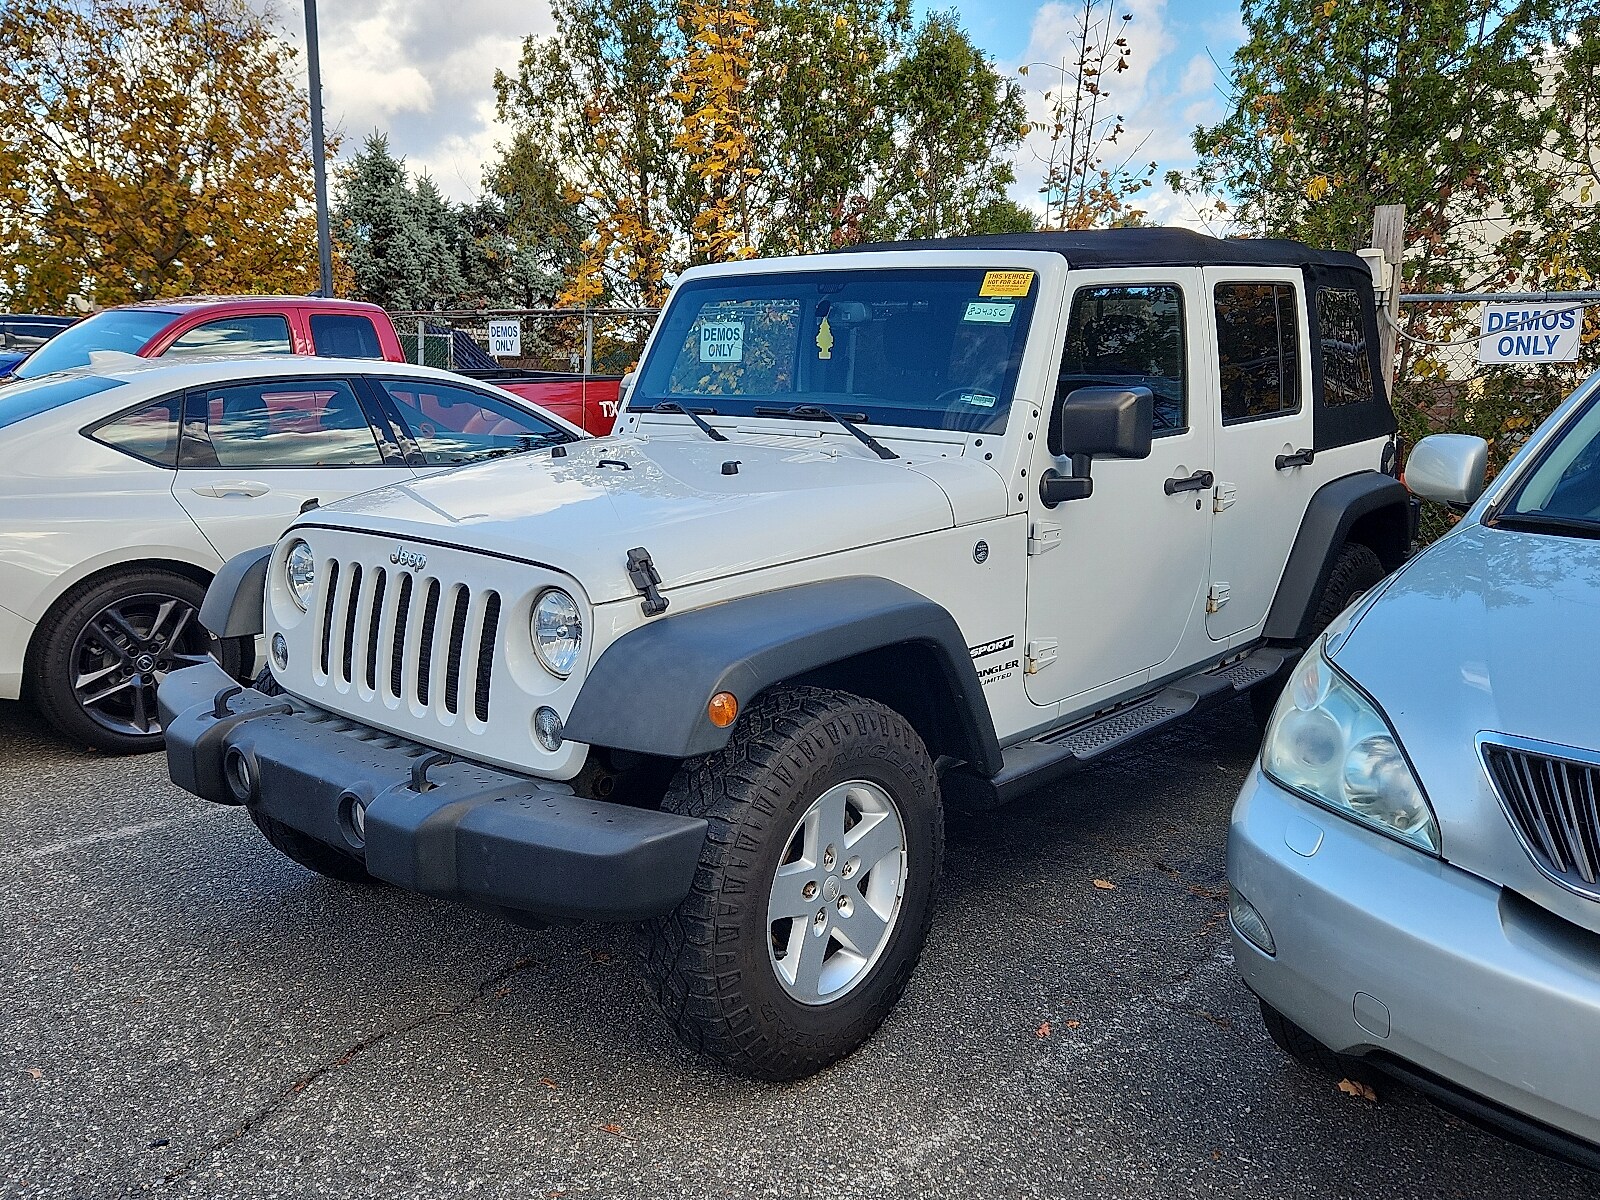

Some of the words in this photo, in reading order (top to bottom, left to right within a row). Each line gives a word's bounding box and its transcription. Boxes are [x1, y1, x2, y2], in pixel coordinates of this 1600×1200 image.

[1487, 309, 1576, 333] DEMOS
[490, 325, 518, 338] DEMOS
[703, 327, 740, 342] DEMOS
[495, 339, 515, 352] ONLY
[708, 343, 735, 358] ONLY
[1497, 334, 1561, 357] ONLY
[389, 544, 427, 573] Jeep
[970, 639, 1014, 658] SPORT
[976, 659, 1019, 678] ANGLER
